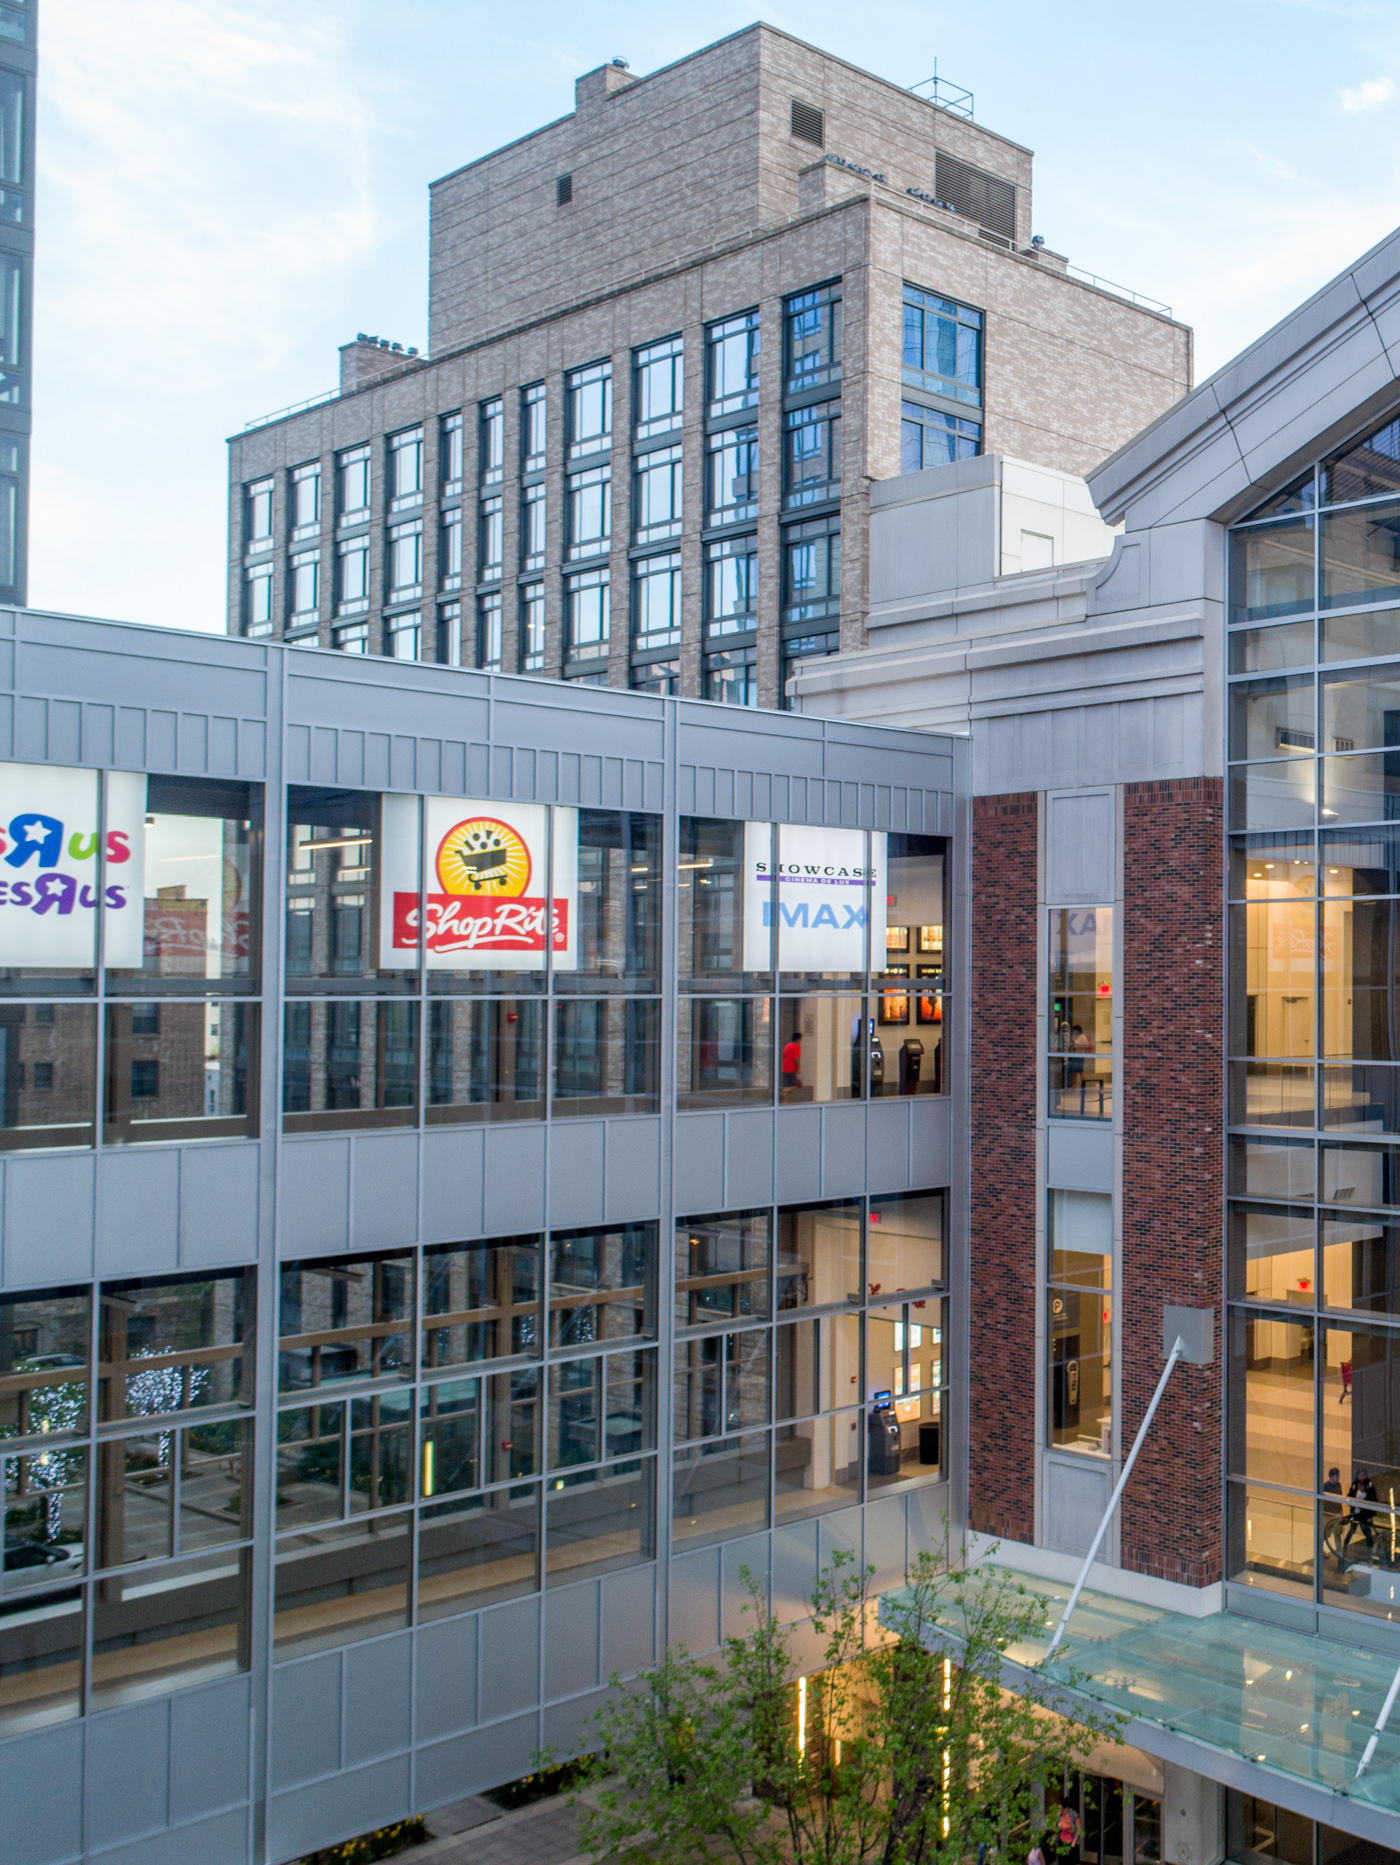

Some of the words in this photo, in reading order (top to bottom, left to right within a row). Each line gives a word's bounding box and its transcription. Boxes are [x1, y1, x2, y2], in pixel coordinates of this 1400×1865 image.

[785, 876, 818, 884] CINEMA
[401, 900, 560, 949] ShopRite
[762, 901, 868, 929] IMAX
